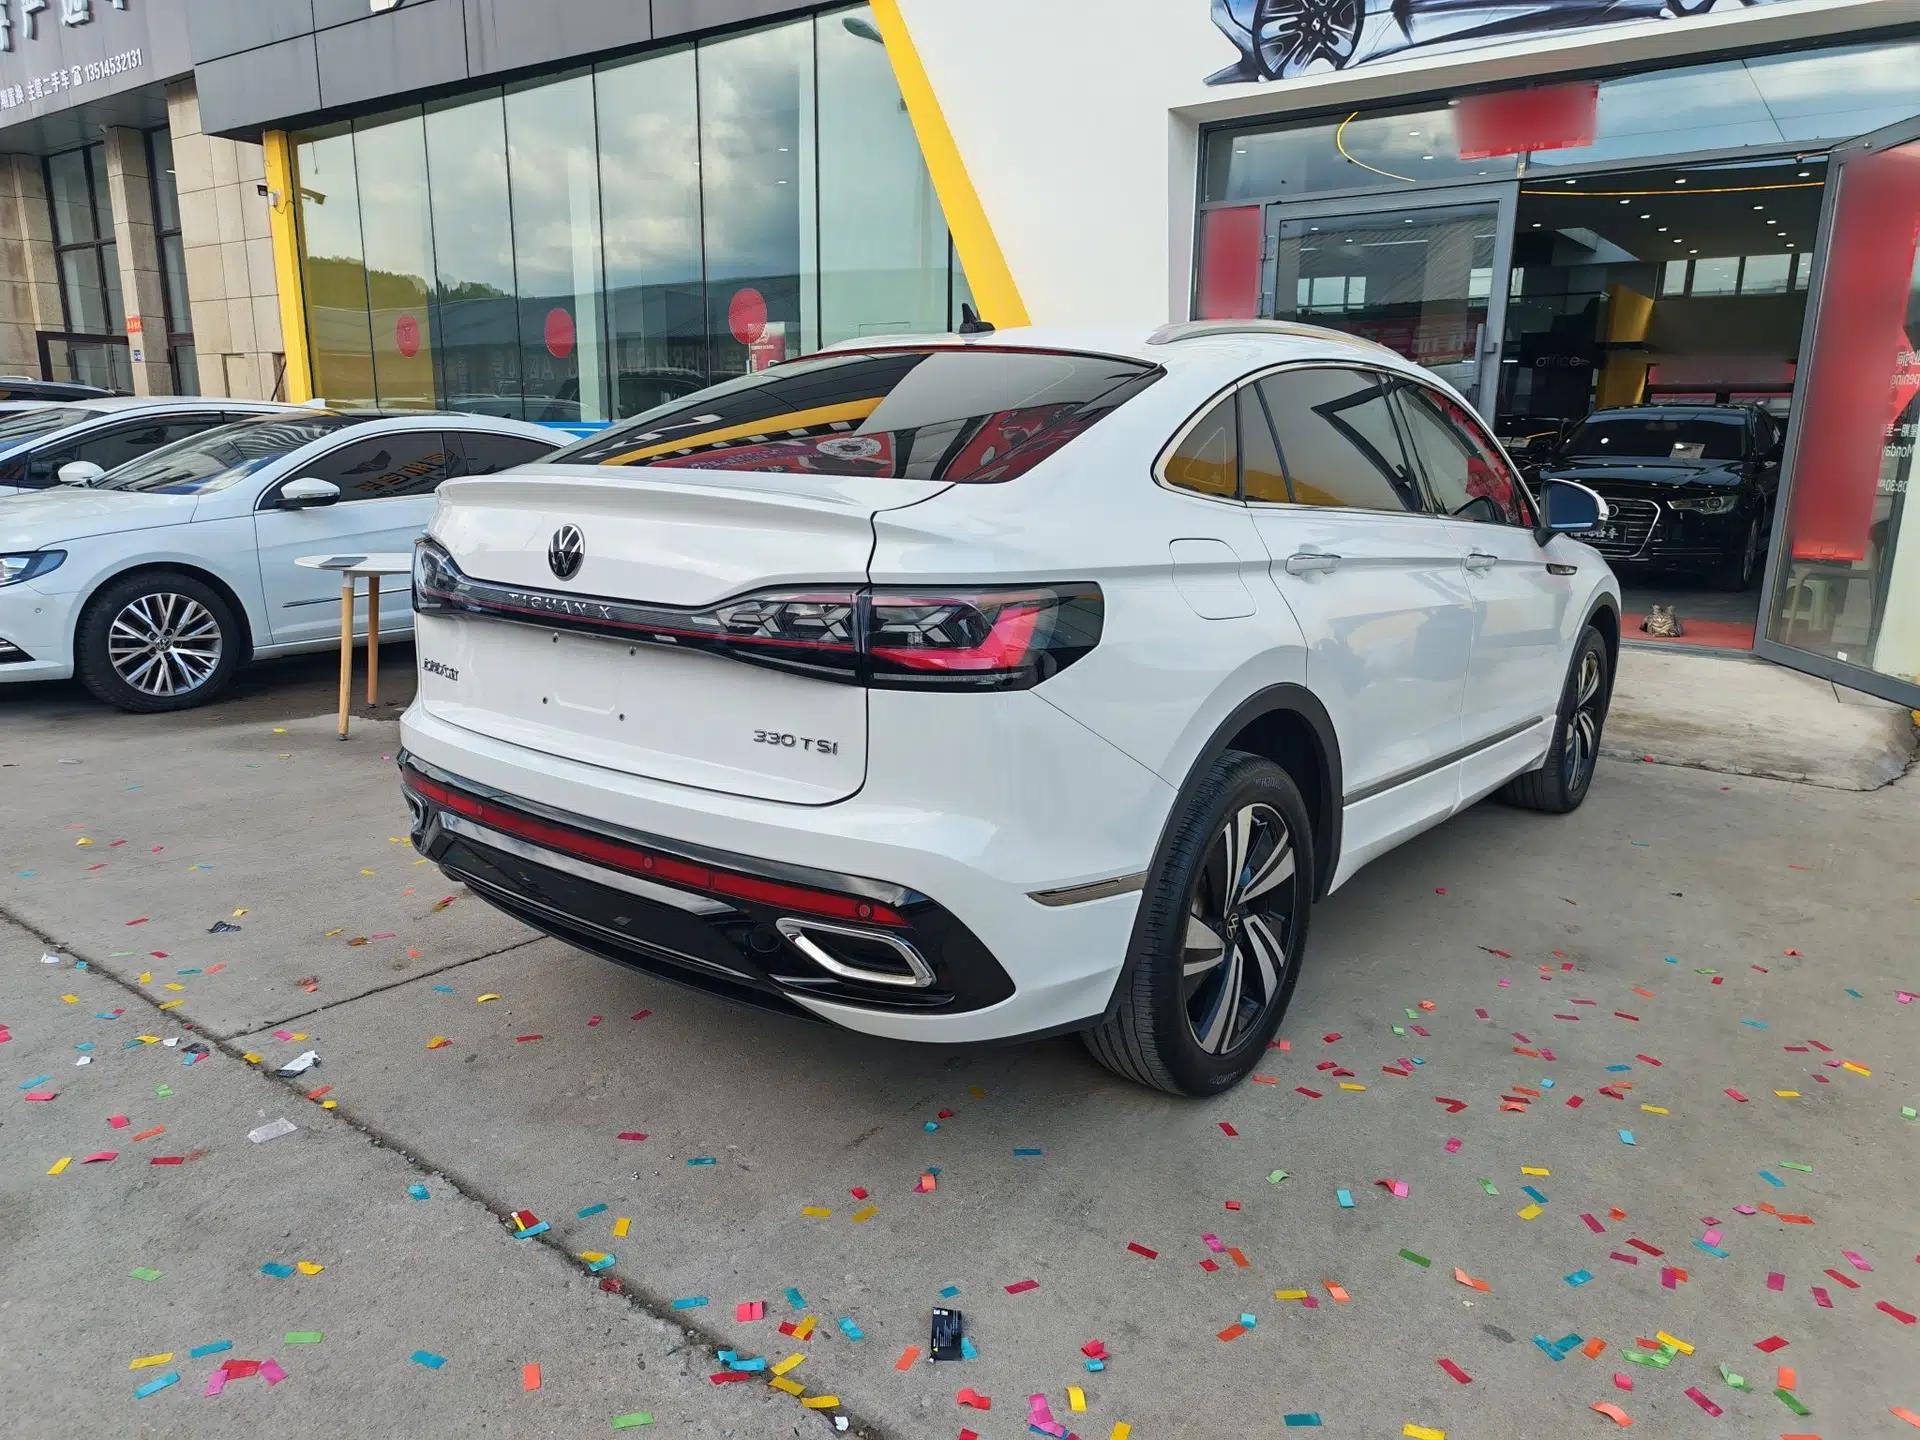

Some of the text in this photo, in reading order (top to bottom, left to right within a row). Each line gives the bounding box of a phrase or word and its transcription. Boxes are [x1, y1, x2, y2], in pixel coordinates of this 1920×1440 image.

[28, 69, 71, 102] 主营二手车
[84, 48, 143, 82] 13514532131
[508, 592, 611, 620] TIGUAN X
[753, 729, 839, 756] 330 TSI
